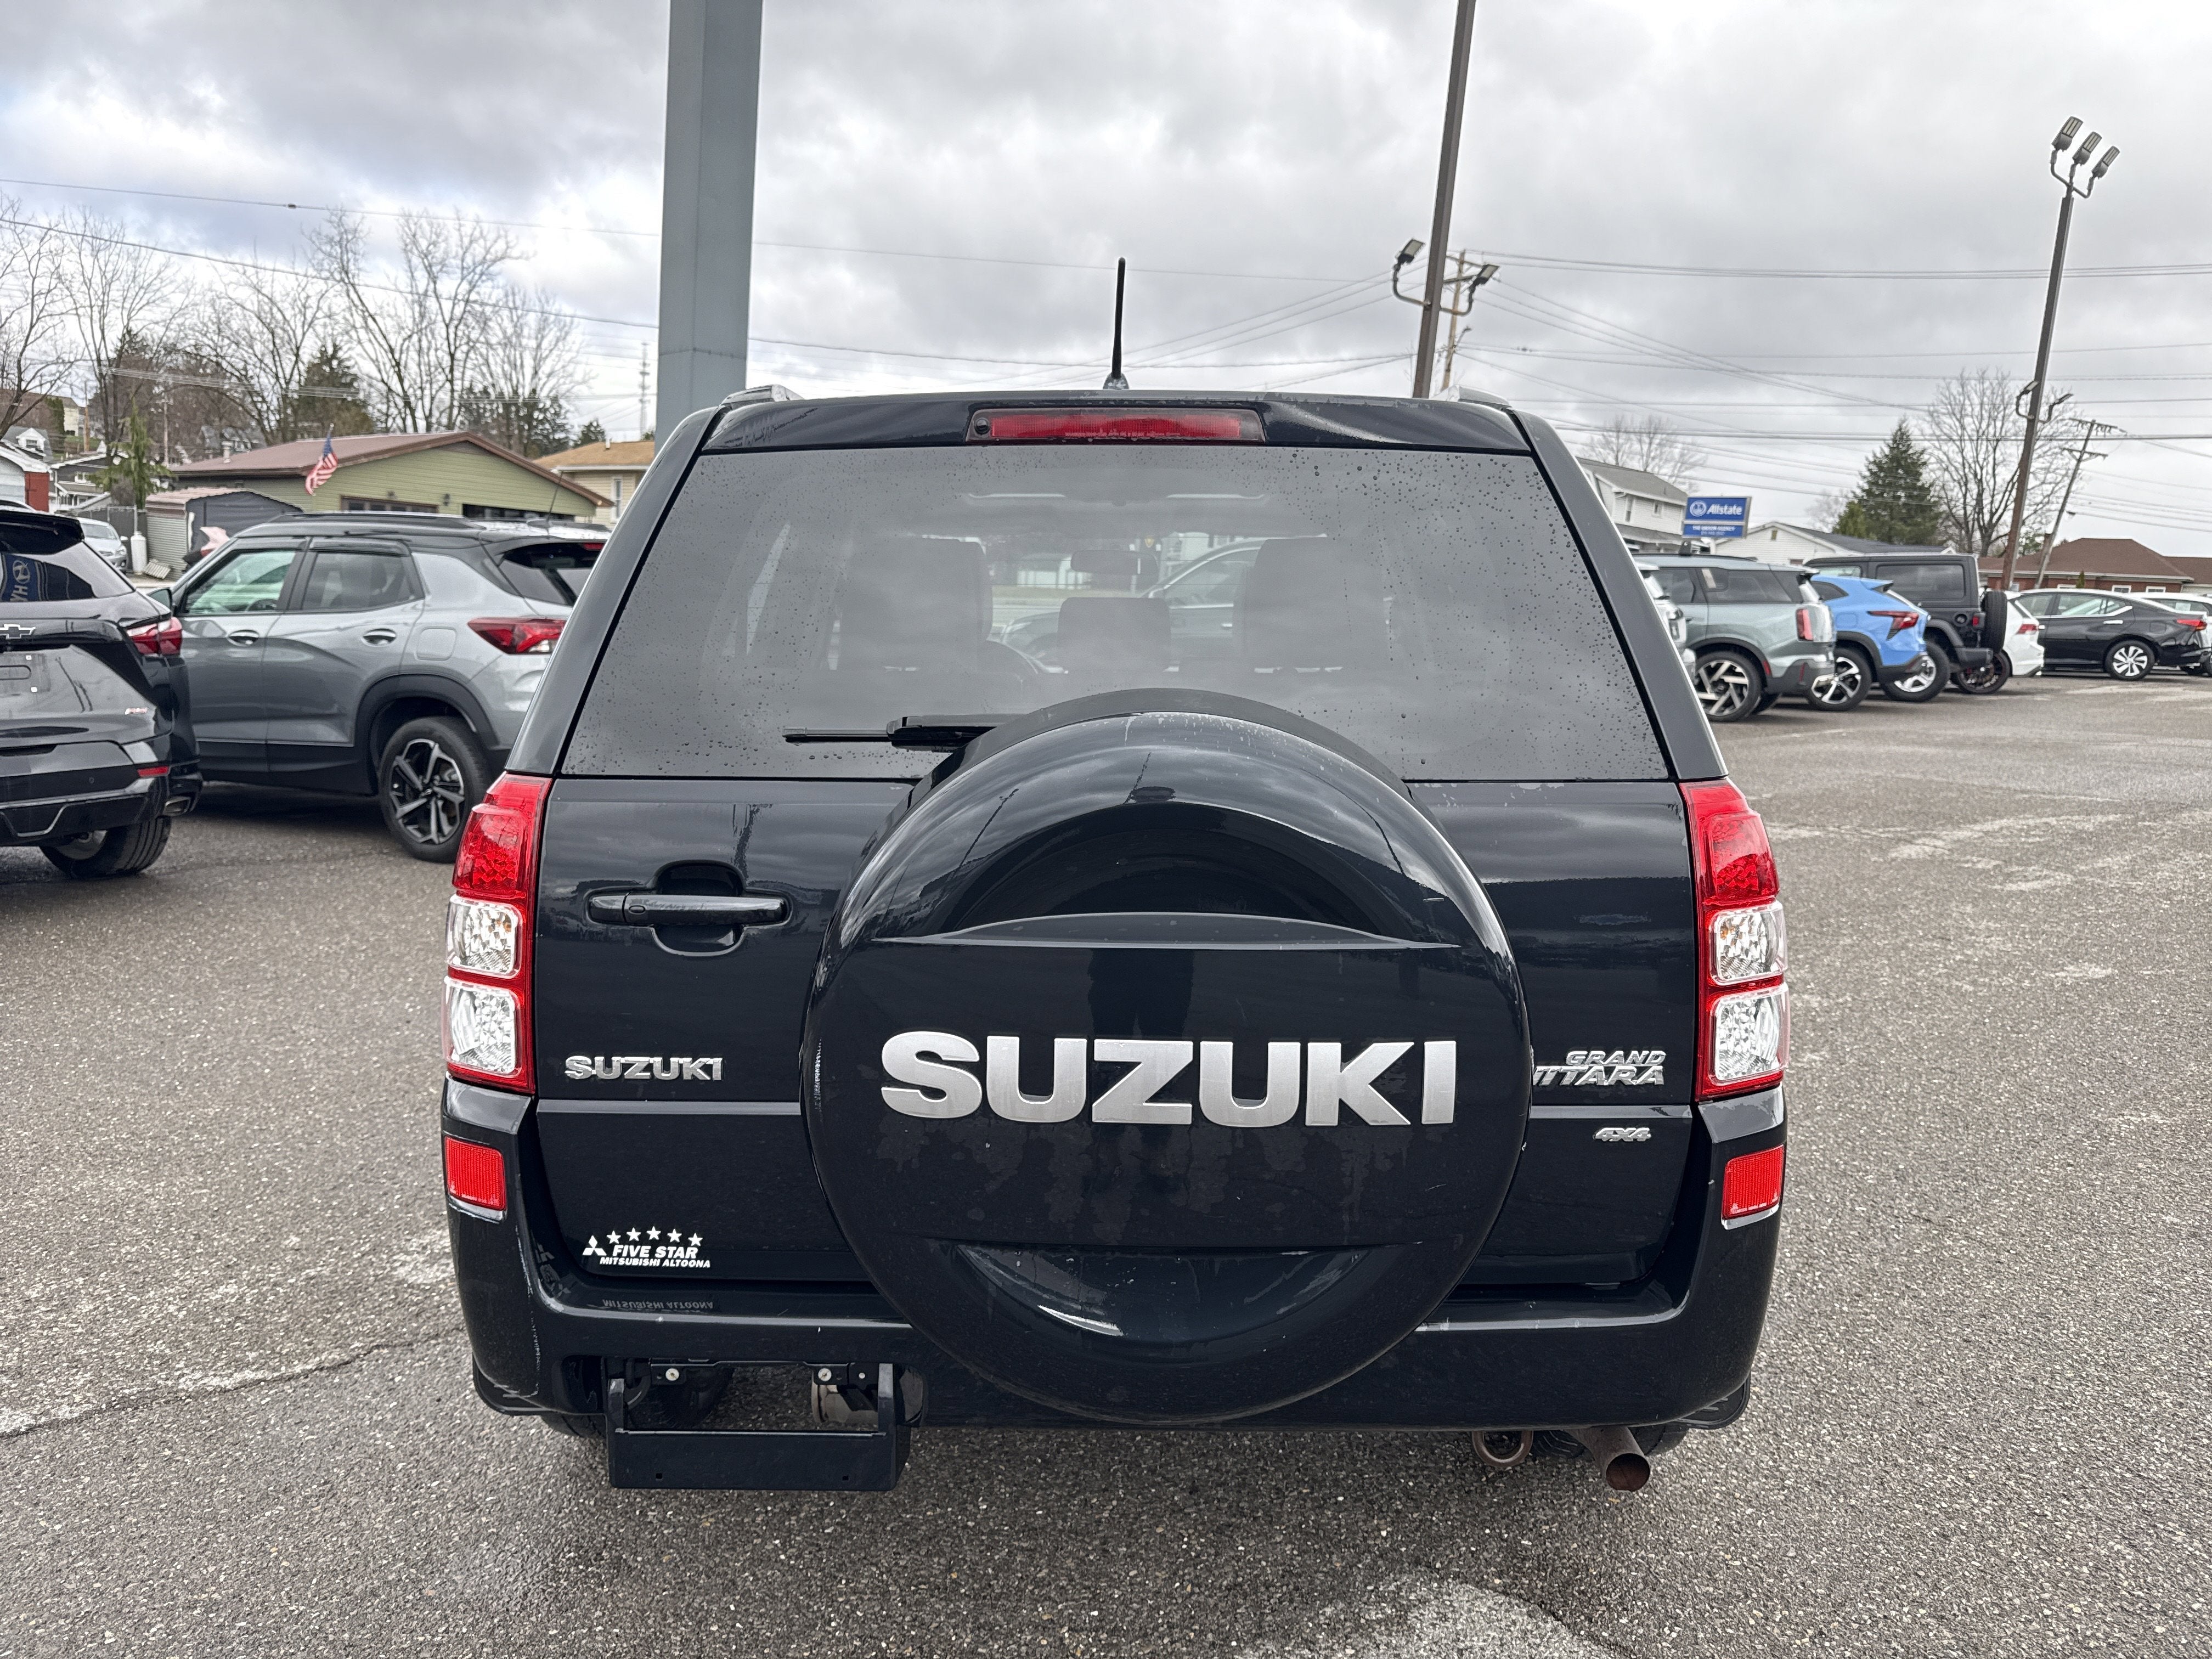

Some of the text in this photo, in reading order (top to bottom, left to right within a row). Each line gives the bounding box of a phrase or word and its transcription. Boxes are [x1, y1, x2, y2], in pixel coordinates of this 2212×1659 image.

[1707, 504, 1742, 515] Allstate
[1565, 1051, 1667, 1065] GRAND
[565, 1056, 724, 1081] SUZUKI
[881, 1031, 1458, 1128] SUZUKI
[612, 1245, 698, 1258] FIVE STAR
[600, 1257, 710, 1268] MITSUBISHI ALTOONA
